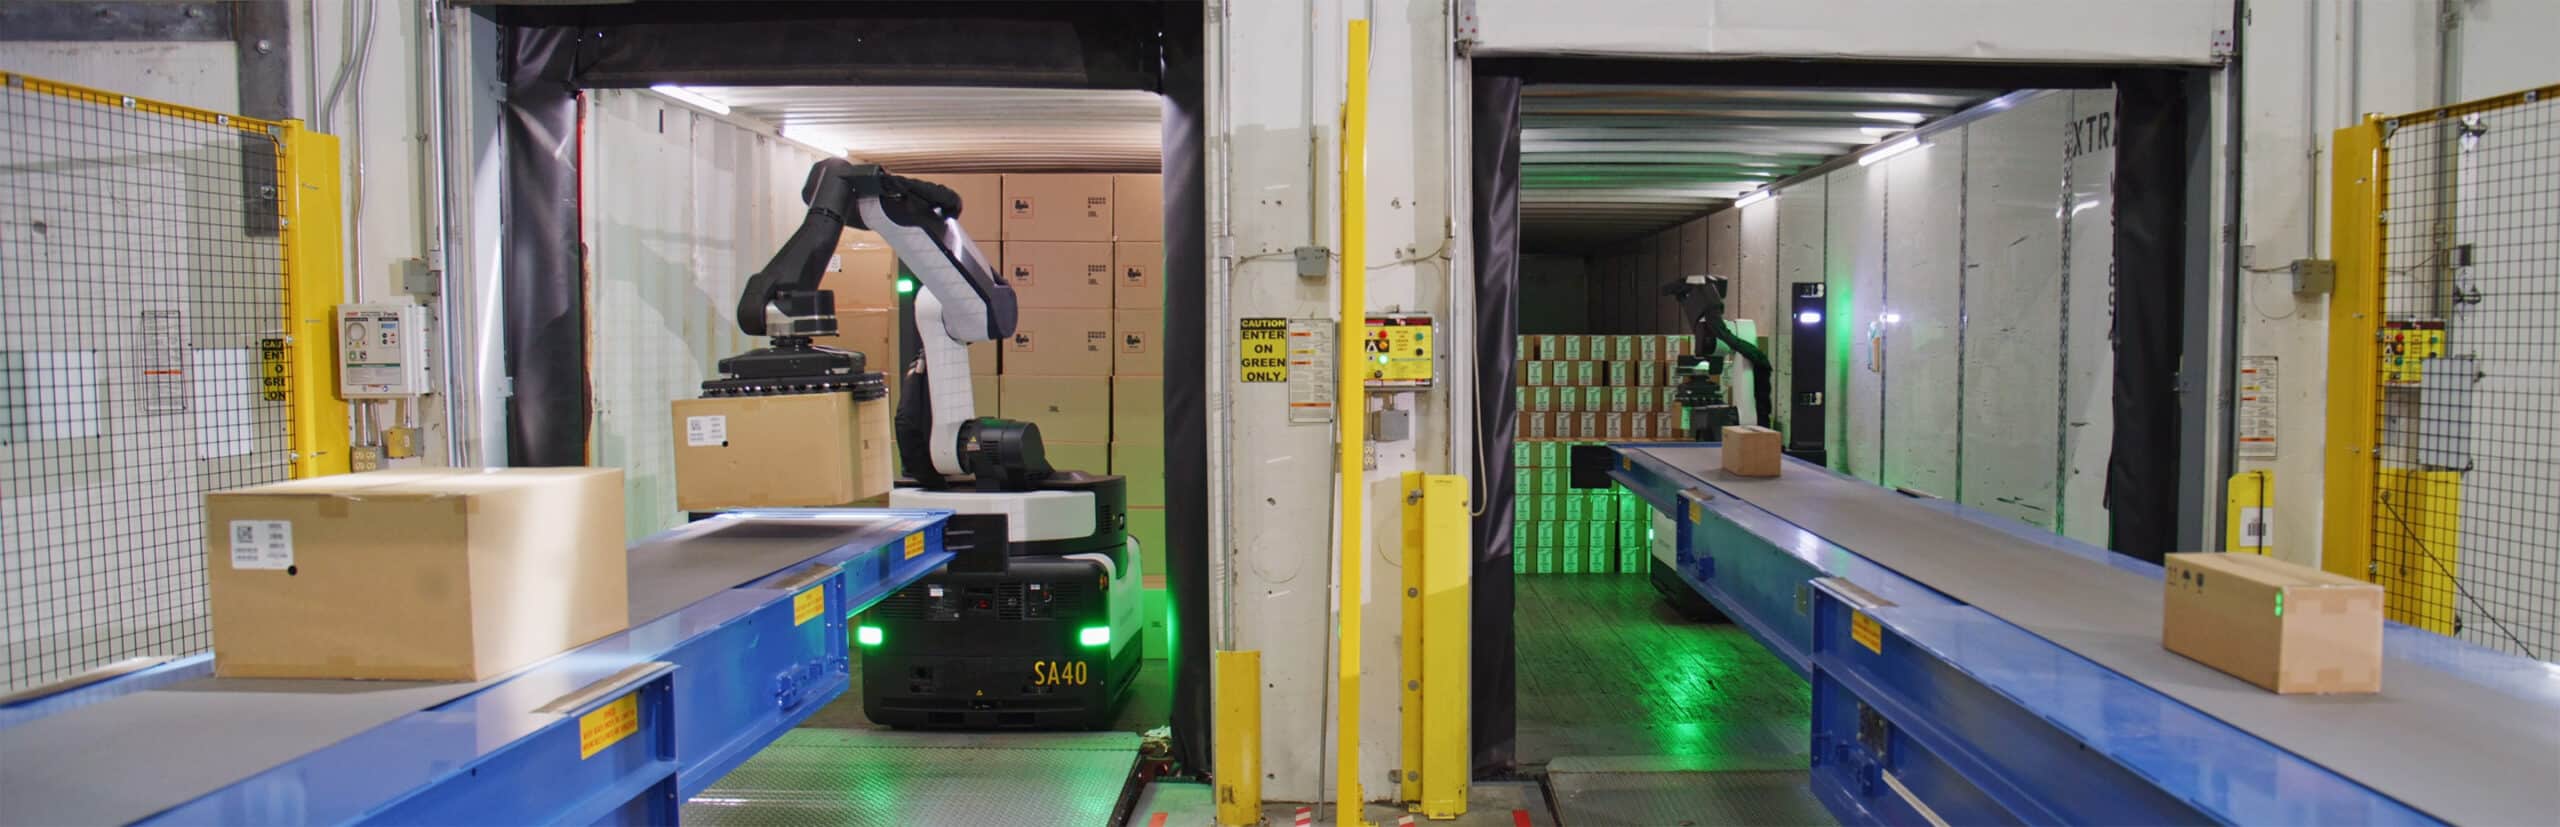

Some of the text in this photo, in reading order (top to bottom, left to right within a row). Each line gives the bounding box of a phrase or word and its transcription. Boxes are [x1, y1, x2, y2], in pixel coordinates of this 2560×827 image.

[1242, 319, 1285, 328] CAUTION
[1242, 330, 1285, 340] ENTER
[1254, 344, 1273, 354] ON
[264, 351, 285, 360] ENT
[1242, 358, 1286, 368] GREEN
[275, 364, 284, 374] O
[1247, 371, 1281, 382] ONLY
[270, 391, 286, 401] ON
[1034, 660, 1088, 686] SA40
